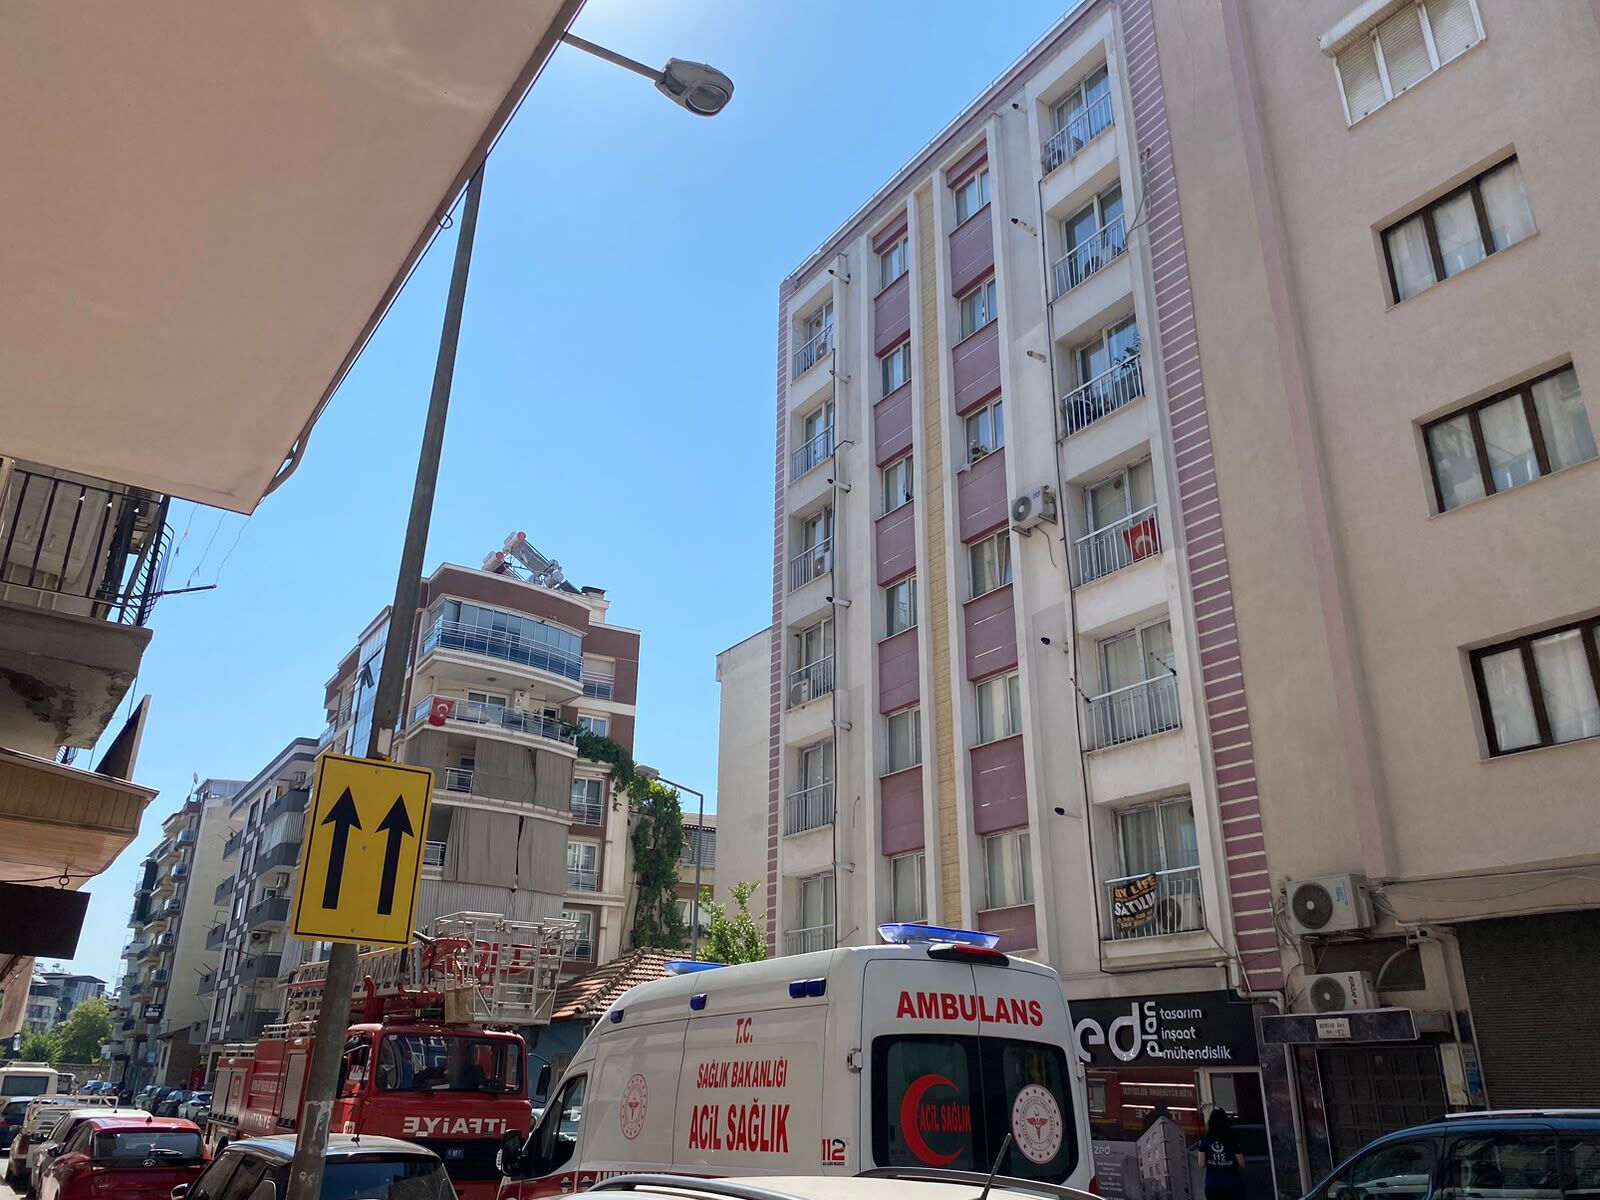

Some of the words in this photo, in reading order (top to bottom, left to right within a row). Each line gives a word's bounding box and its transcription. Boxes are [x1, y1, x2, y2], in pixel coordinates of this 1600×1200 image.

[896, 991, 1043, 1027] AMBULANS
[1160, 1008, 1202, 1020] tasarım
[736, 1017, 753, 1044] T.C.
[1142, 1001, 1163, 1057] plan
[1161, 1027, 1196, 1041] inşaat
[1164, 1046, 1232, 1059] mühendislik
[697, 1060, 730, 1088] SAĞLIK
[731, 1056, 788, 1088] BAKANLIĞI
[726, 1097, 790, 1152] SAĞLIK
[822, 1138, 846, 1161] 112
